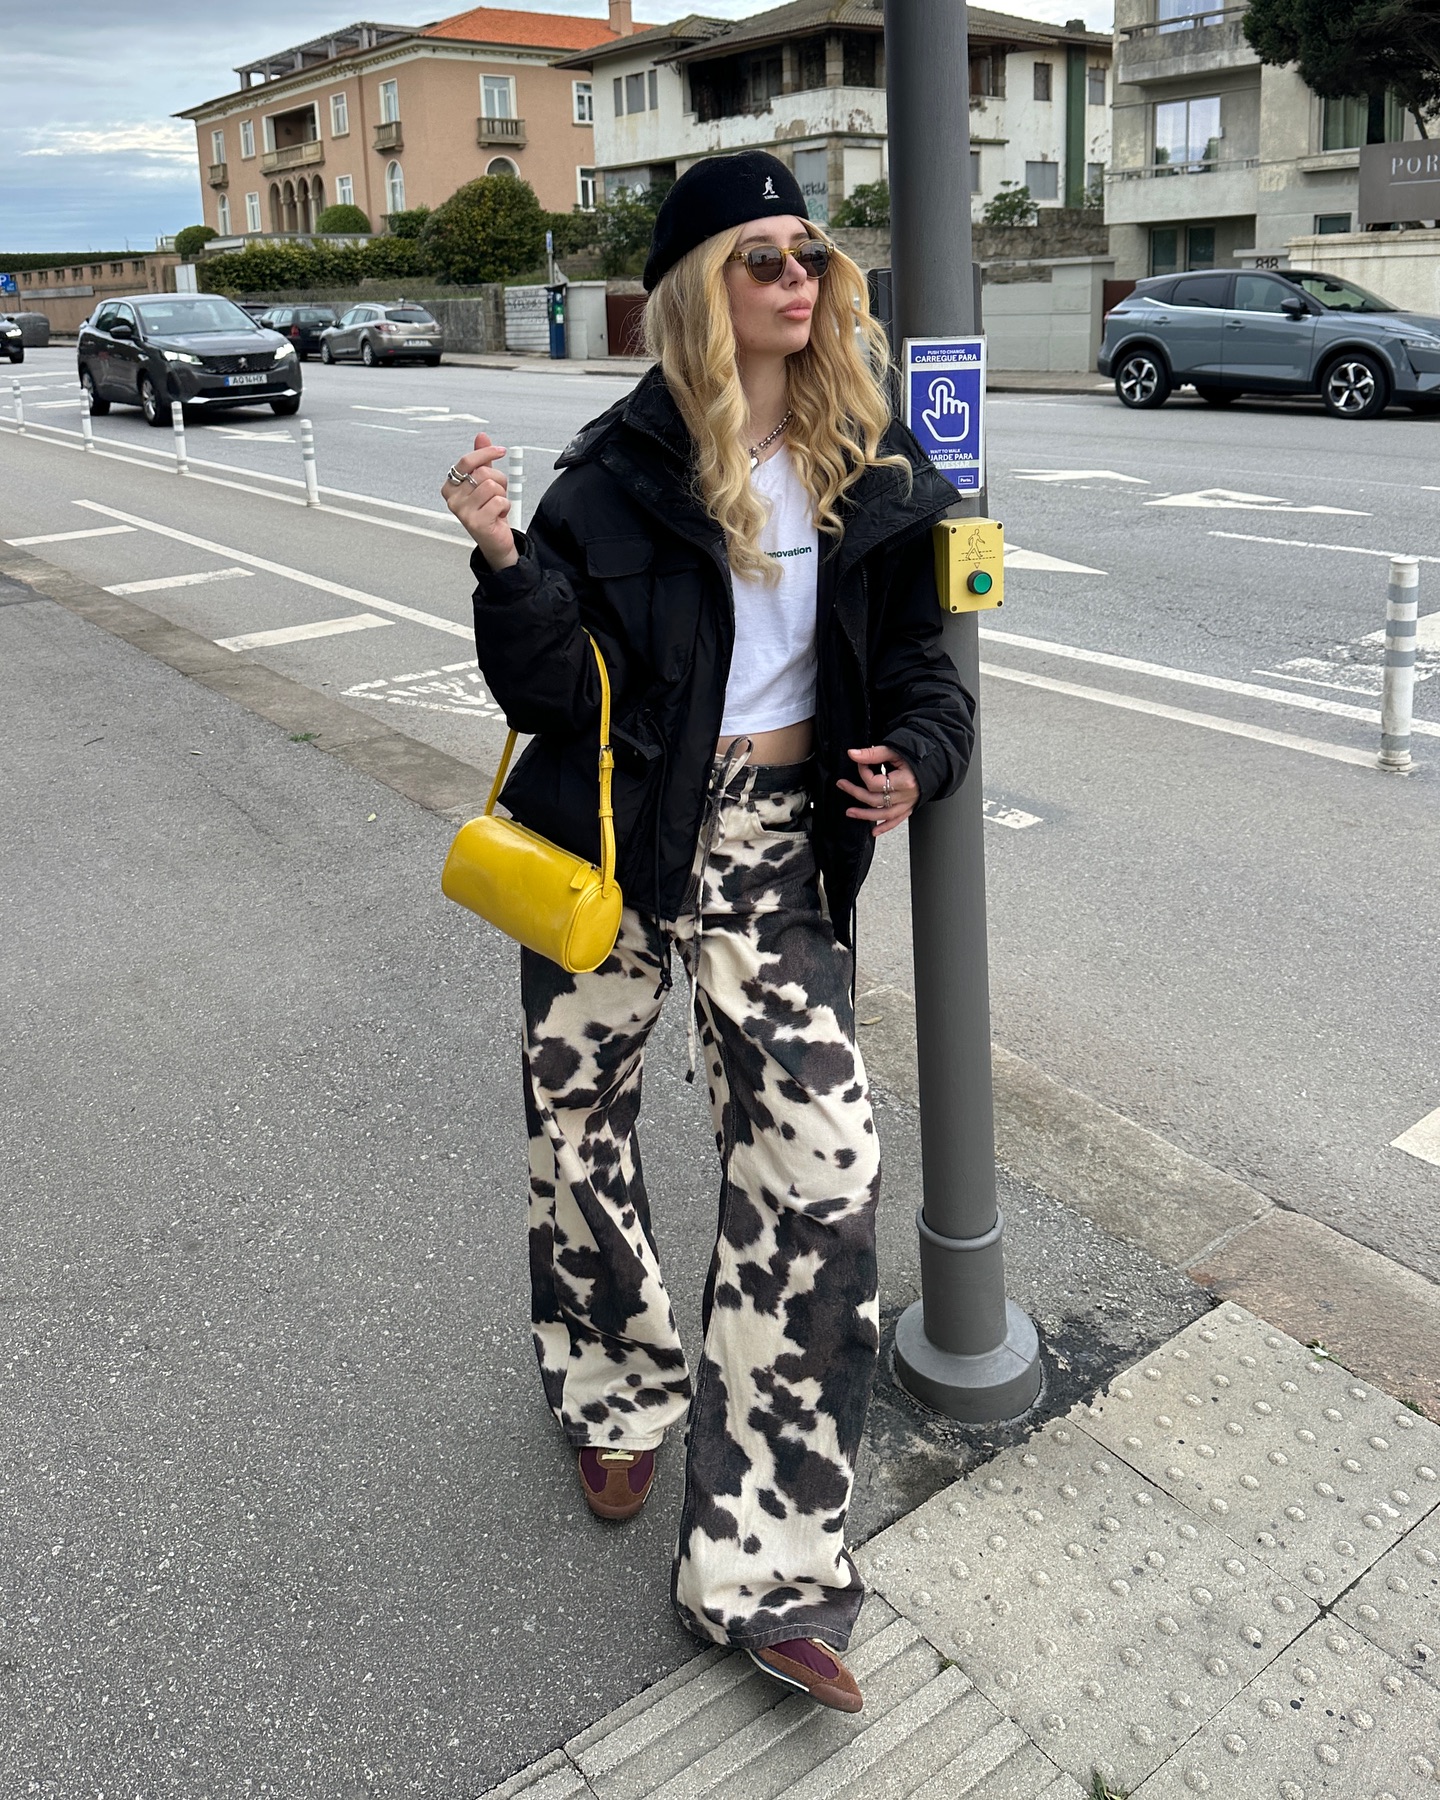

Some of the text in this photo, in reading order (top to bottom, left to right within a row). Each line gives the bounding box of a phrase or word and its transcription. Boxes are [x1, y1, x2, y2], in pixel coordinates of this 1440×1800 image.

[1391, 154, 1440, 175] POR
[1255, 256, 1279, 269] 818
[915, 353, 977, 363] CARREGUE PARA
[954, 453, 973, 461] PARA
